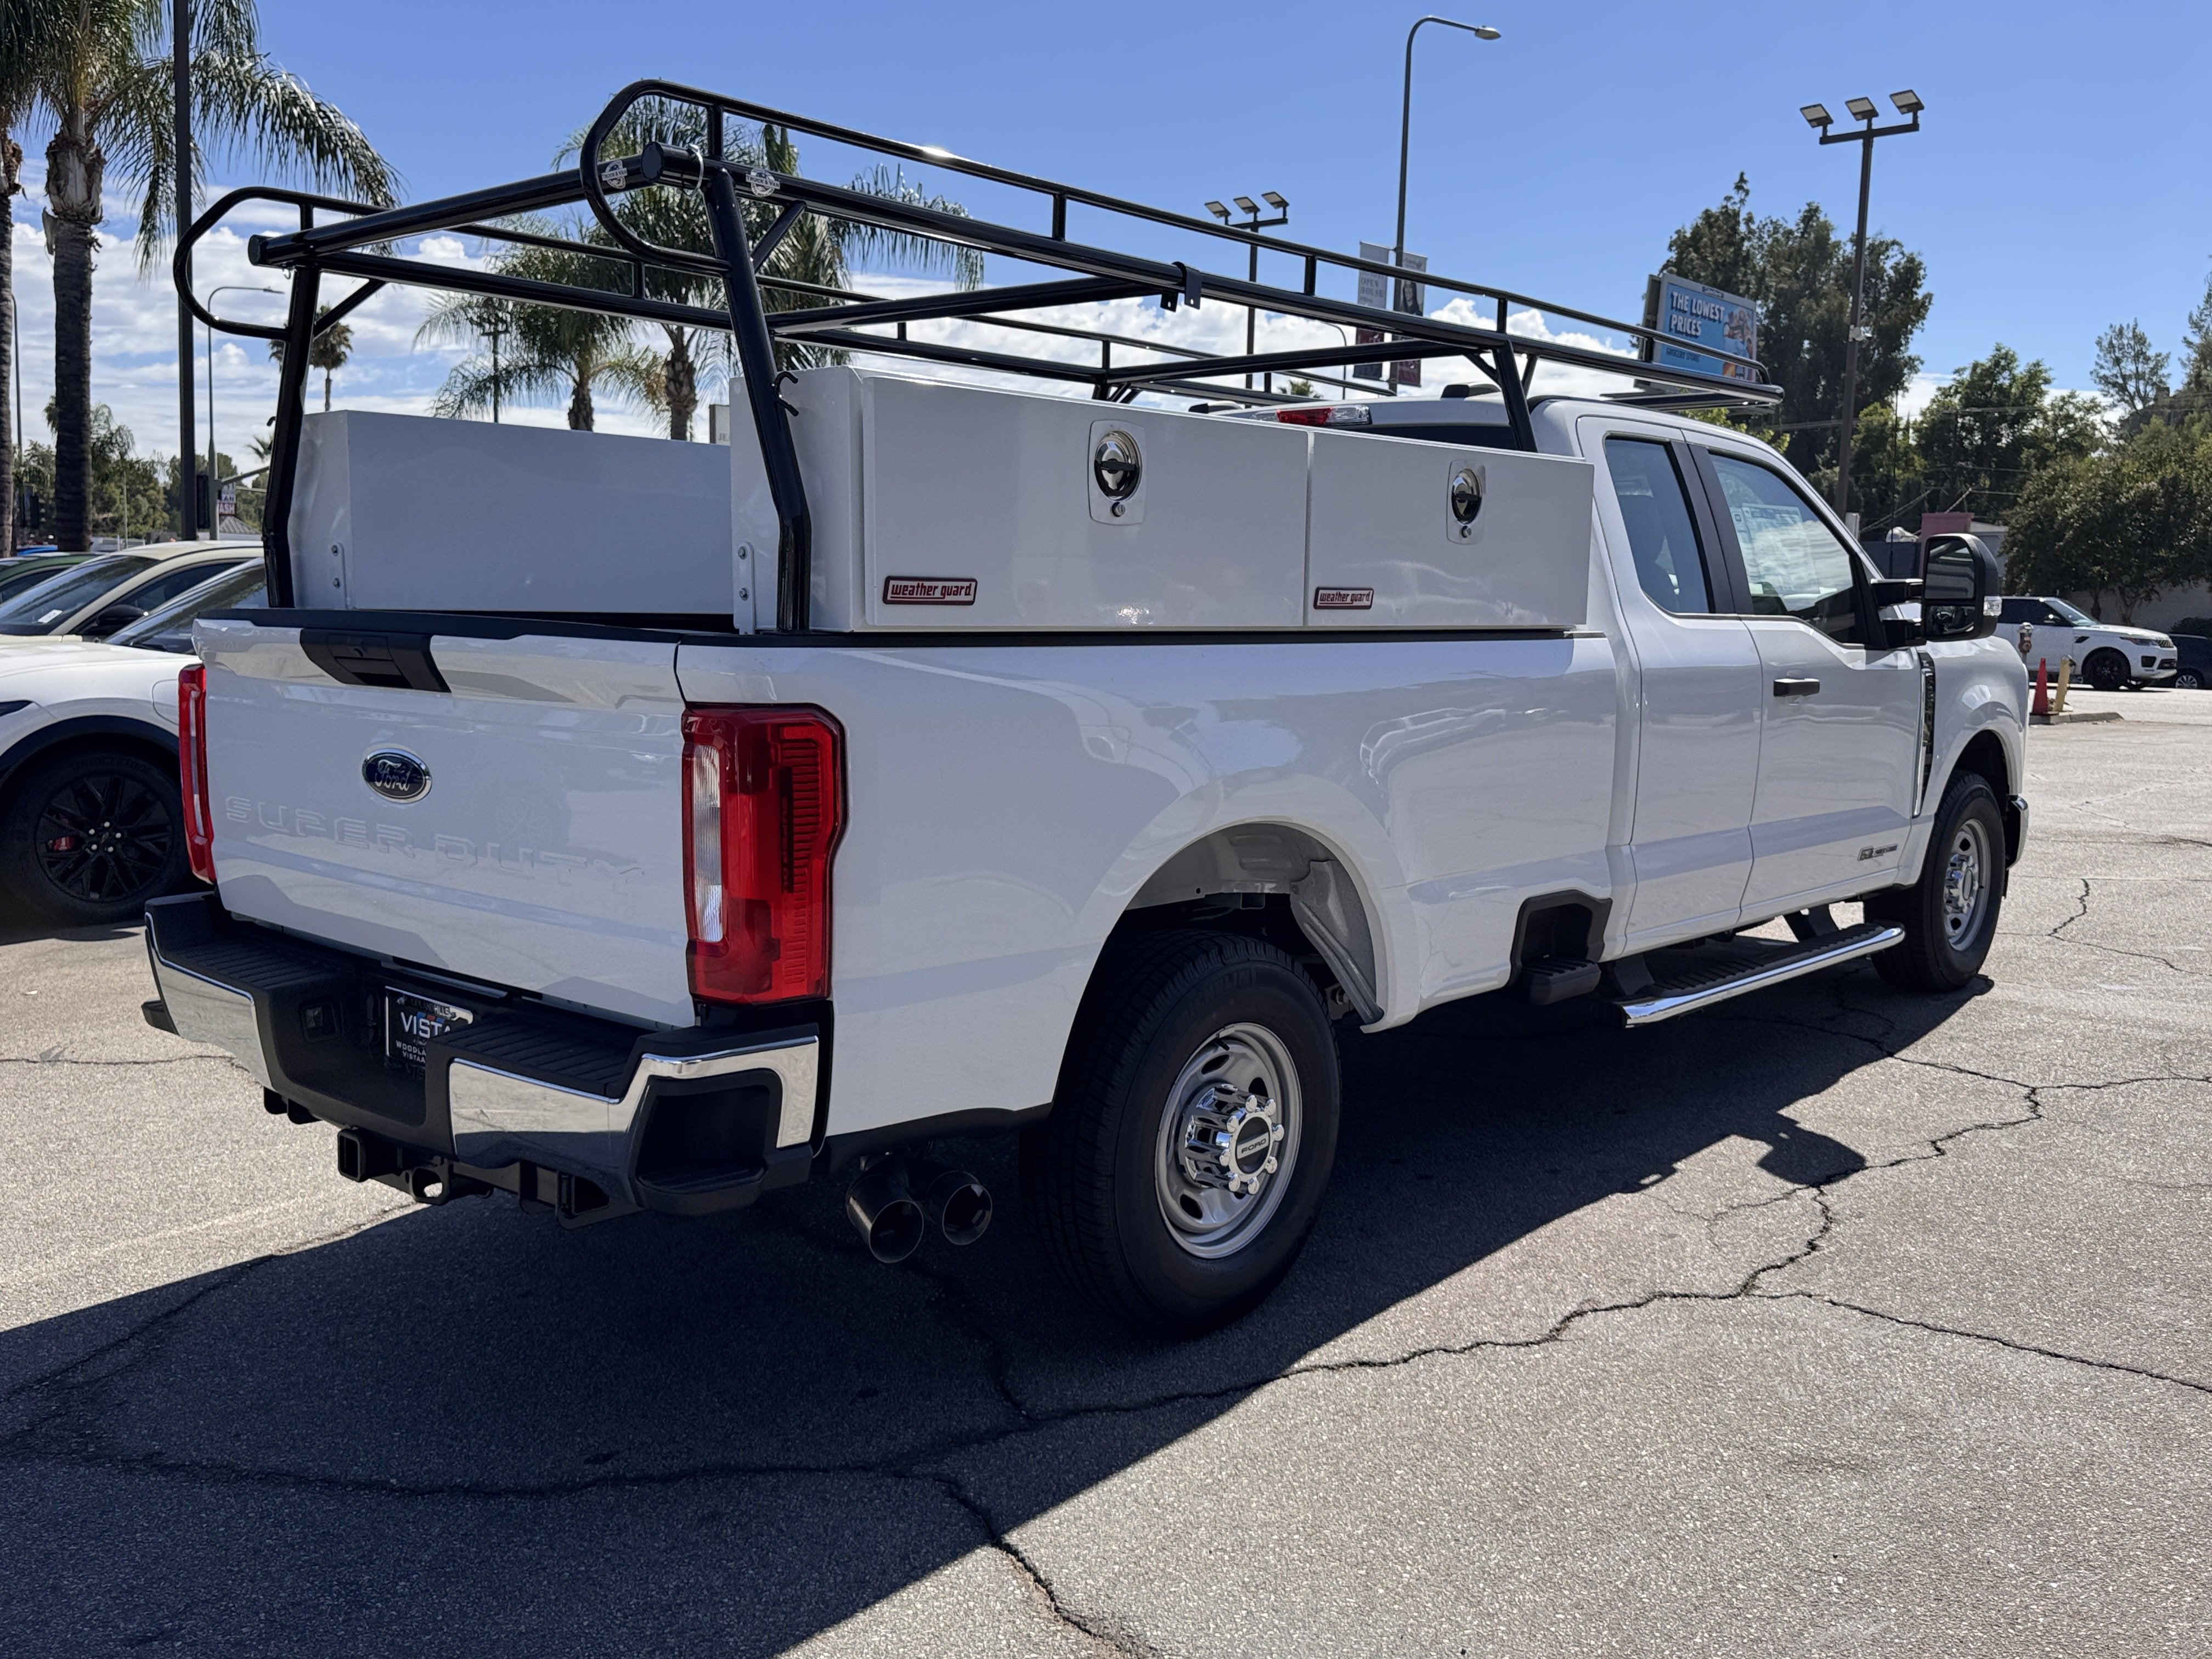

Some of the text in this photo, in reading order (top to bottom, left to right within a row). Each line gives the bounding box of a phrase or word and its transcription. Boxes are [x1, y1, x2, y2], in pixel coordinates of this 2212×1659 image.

[747, 176, 764, 184] TRUCK
[1672, 291, 1690, 314] THE
[1691, 298, 1725, 323] LOWEST
[1671, 314, 1701, 337] PRICES
[891, 583, 972, 599] weather guard
[1319, 591, 1371, 604] weather guard
[375, 759, 410, 791] Ford
[224, 795, 416, 859] SUPER
[396, 1040, 427, 1056] WOODLA
[402, 1050, 426, 1064] VISTAA
[1241, 1138, 1267, 1154] FORD
